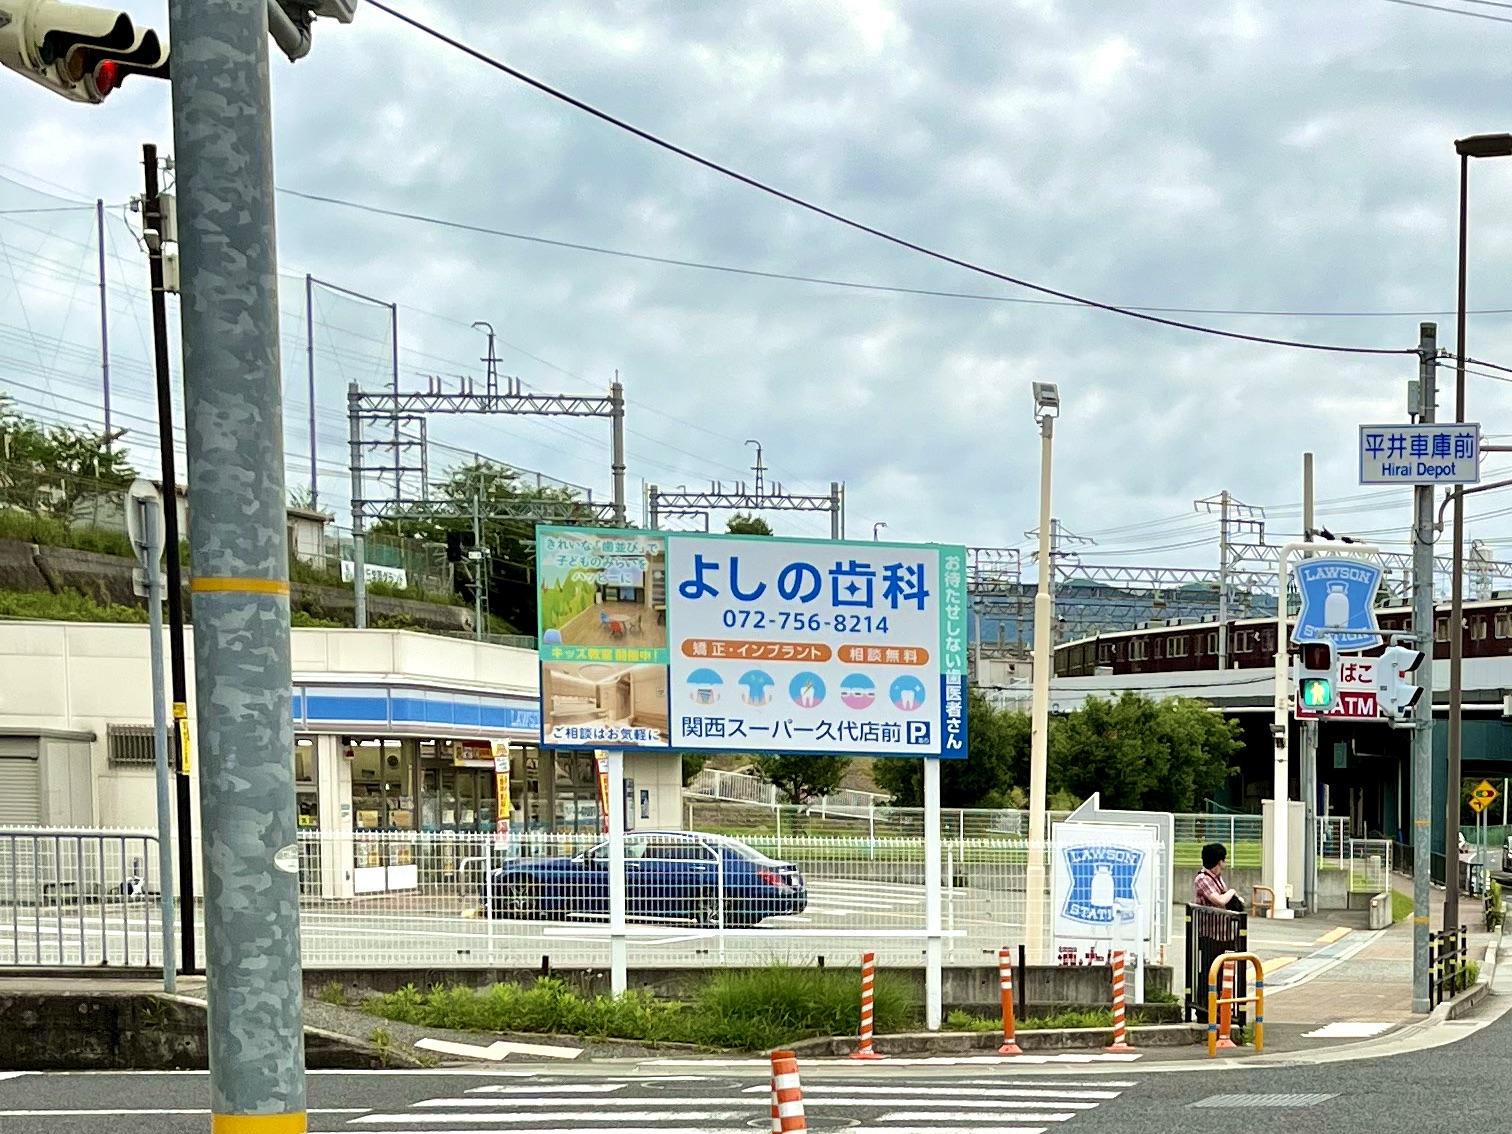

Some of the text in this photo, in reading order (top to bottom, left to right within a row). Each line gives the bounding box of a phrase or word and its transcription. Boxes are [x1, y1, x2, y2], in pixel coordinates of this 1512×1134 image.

[1365, 433, 1474, 459] 平井車庫前
[1382, 462, 1456, 478] Hirai Depot
[678, 554, 930, 611] よしの歯科
[1304, 567, 1371, 585] LAWSON
[723, 609, 889, 634] 072-756-8214
[850, 647, 918, 664] 相談無料
[944, 555, 963, 750] お待たせしない歯医者さん
[553, 727, 660, 741] ご相談はお気軽に
[682, 716, 902, 744] 関西スーパー久代店前
[910, 722, 927, 744] P
[1070, 850, 1138, 865] LAWSON
